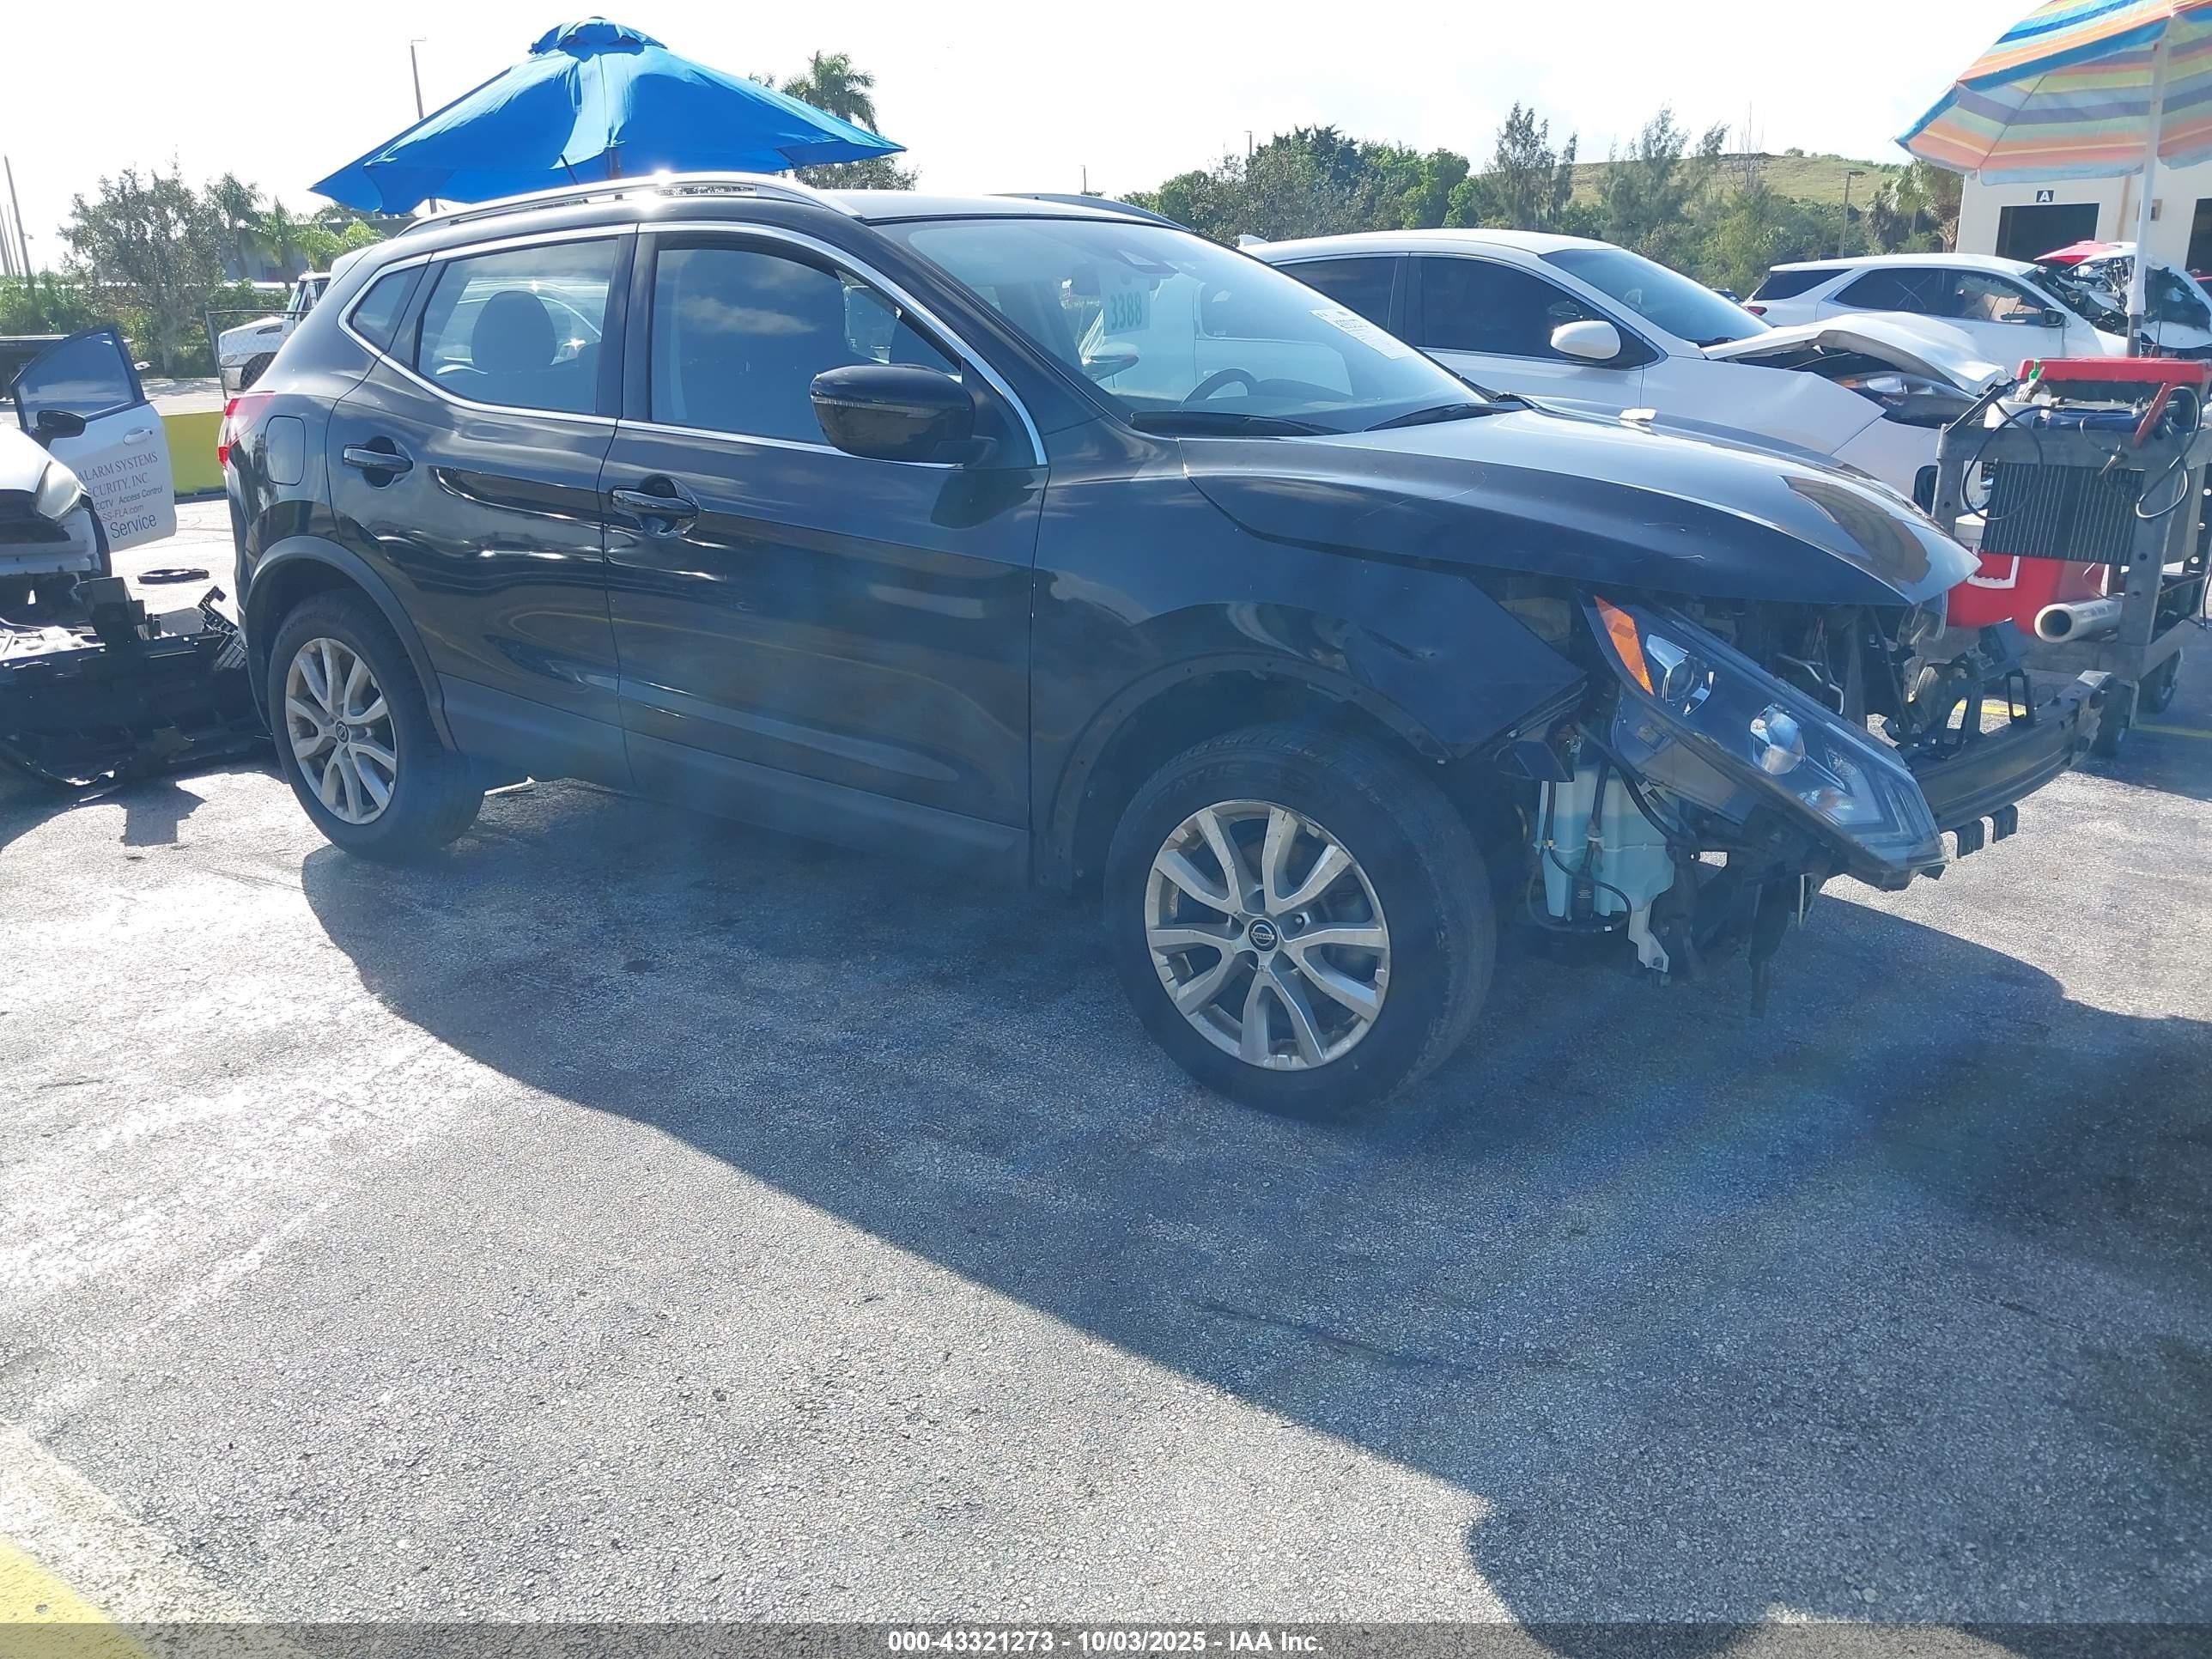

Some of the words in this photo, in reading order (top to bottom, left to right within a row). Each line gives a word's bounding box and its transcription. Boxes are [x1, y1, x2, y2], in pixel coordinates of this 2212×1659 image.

[2039, 191, 2051, 202] A
[1110, 291, 1142, 331] 3388
[78, 463, 115, 482] ALARM
[115, 452, 158, 473] SYSTEMS
[131, 472, 149, 487] INC
[95, 497, 113, 511] CCTV
[119, 493, 141, 505] Access
[142, 485, 163, 497] Control
[110, 514, 157, 538] Service
